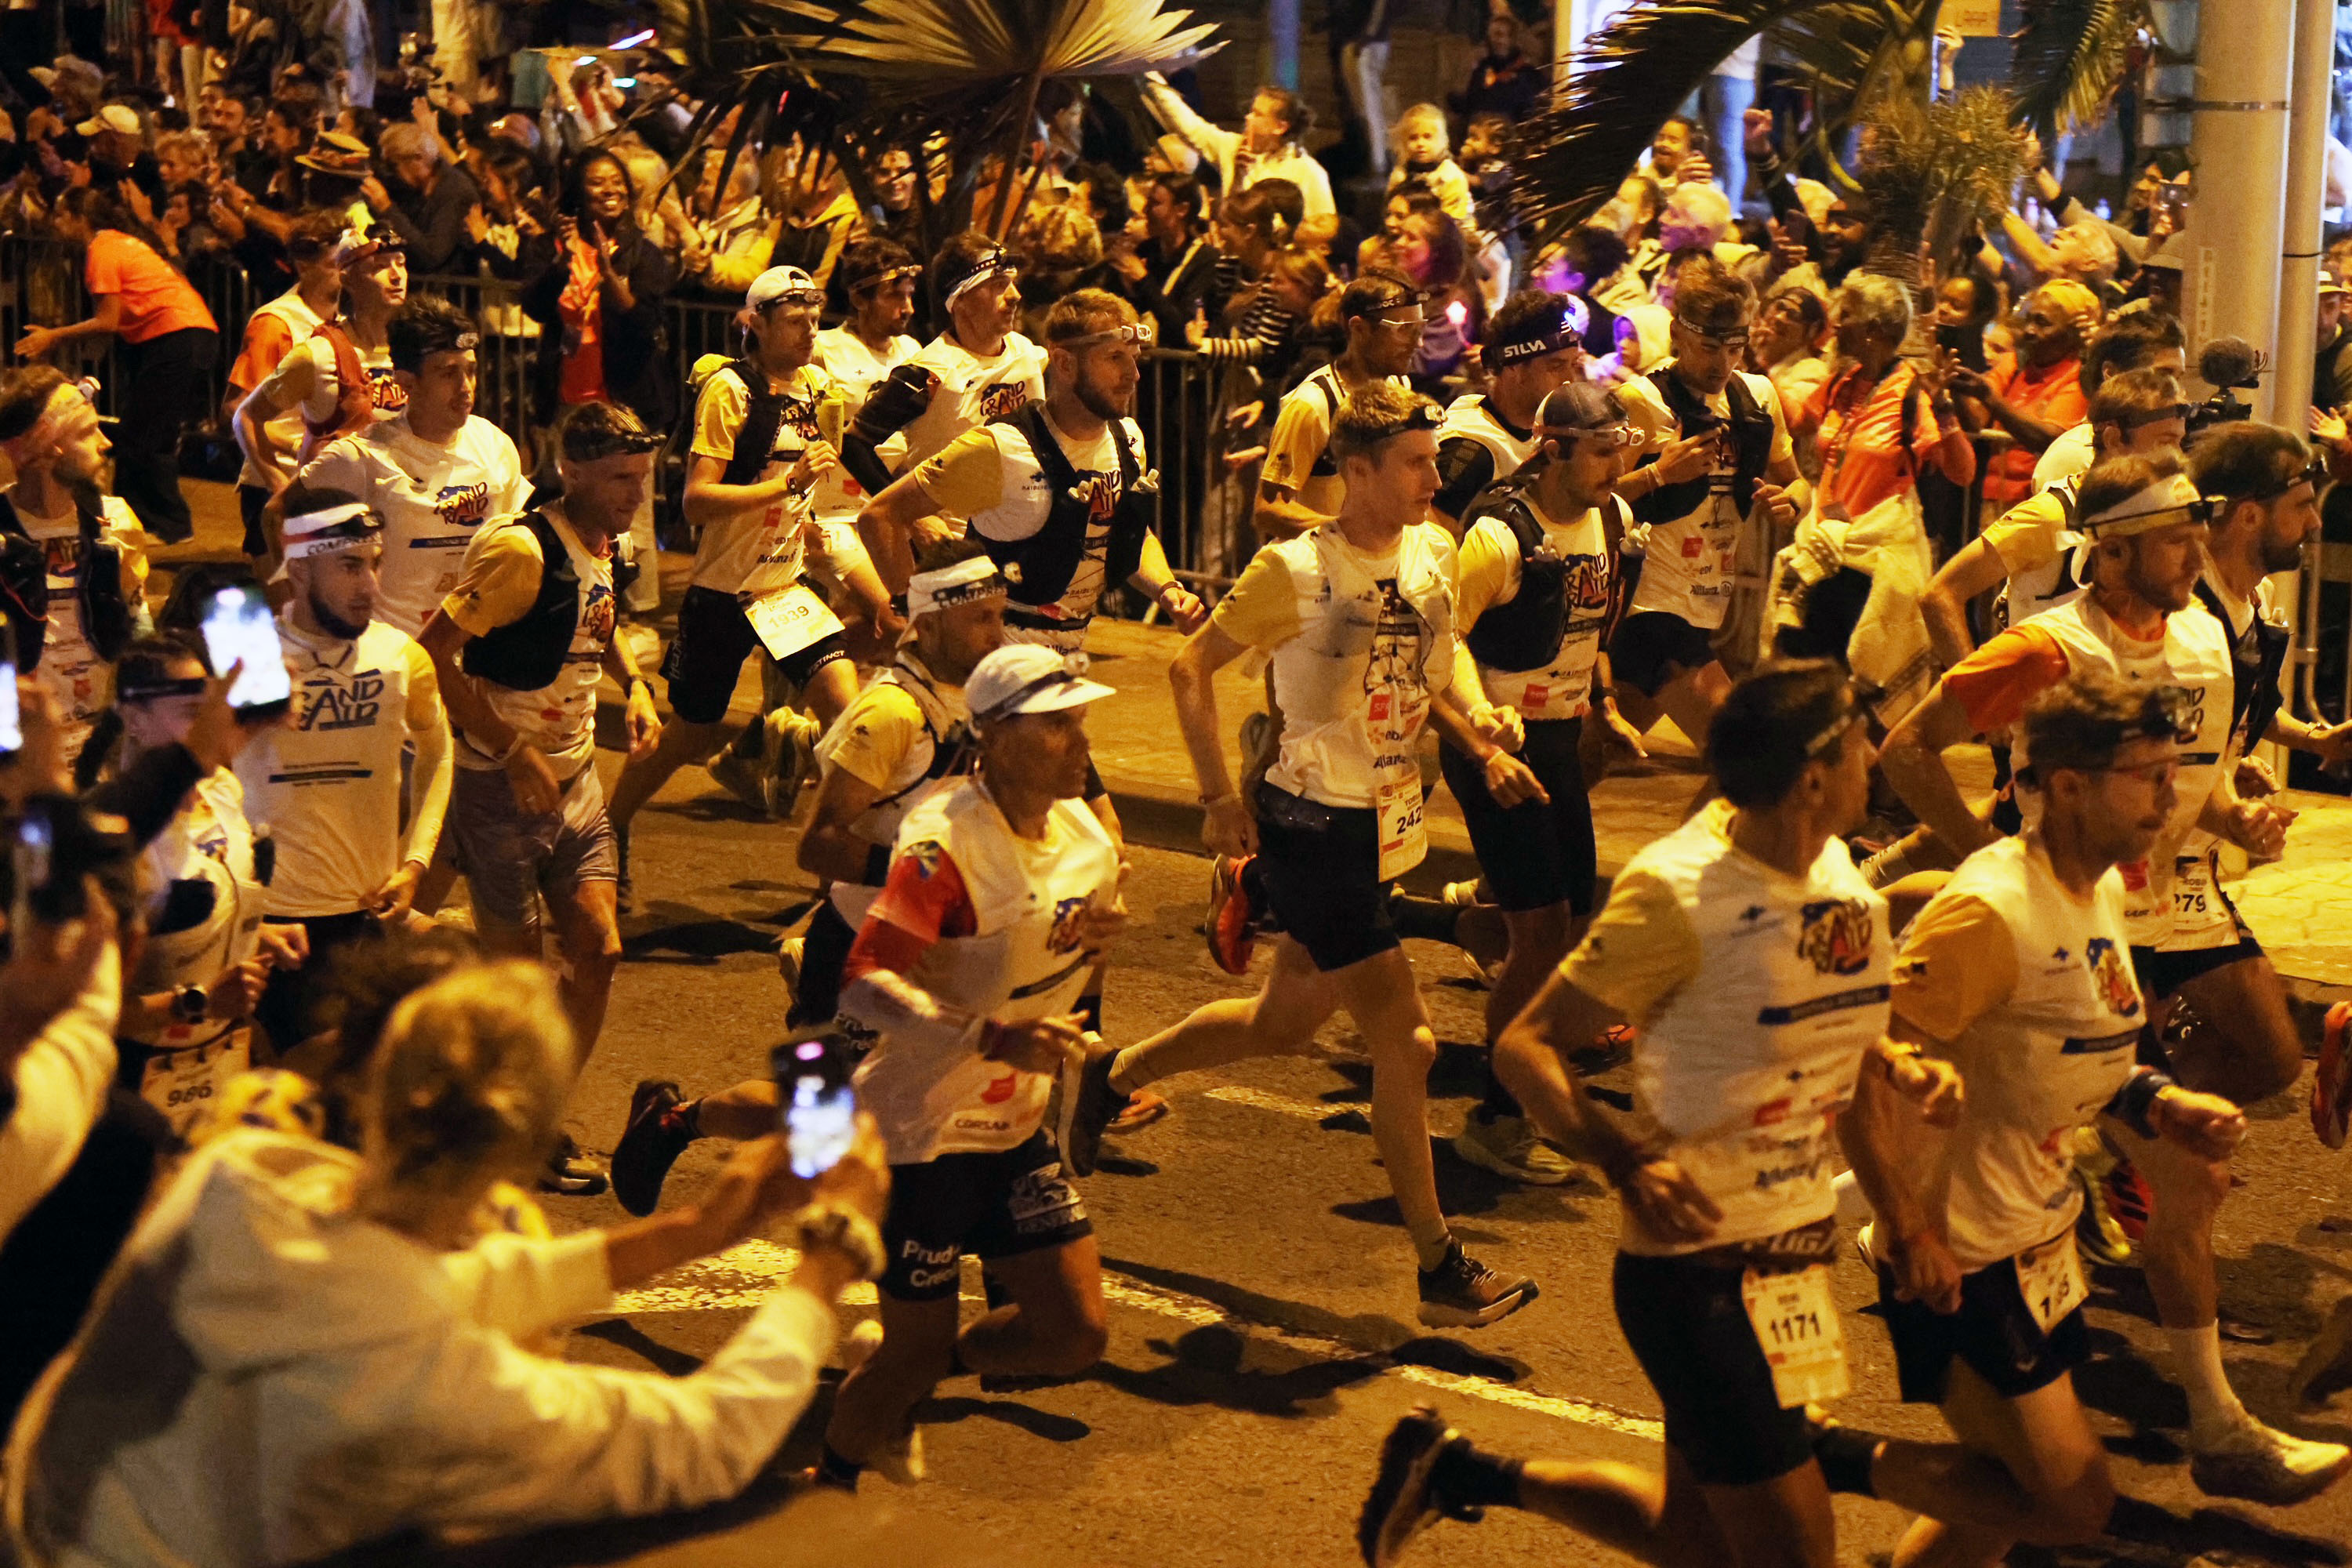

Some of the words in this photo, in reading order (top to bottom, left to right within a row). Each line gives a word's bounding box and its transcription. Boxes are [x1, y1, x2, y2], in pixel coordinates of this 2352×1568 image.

[1504, 339, 1546, 358] SILVA
[768, 605, 810, 629] 1939
[1396, 805, 1422, 835] 242
[1770, 1311, 1821, 1345] 1171
